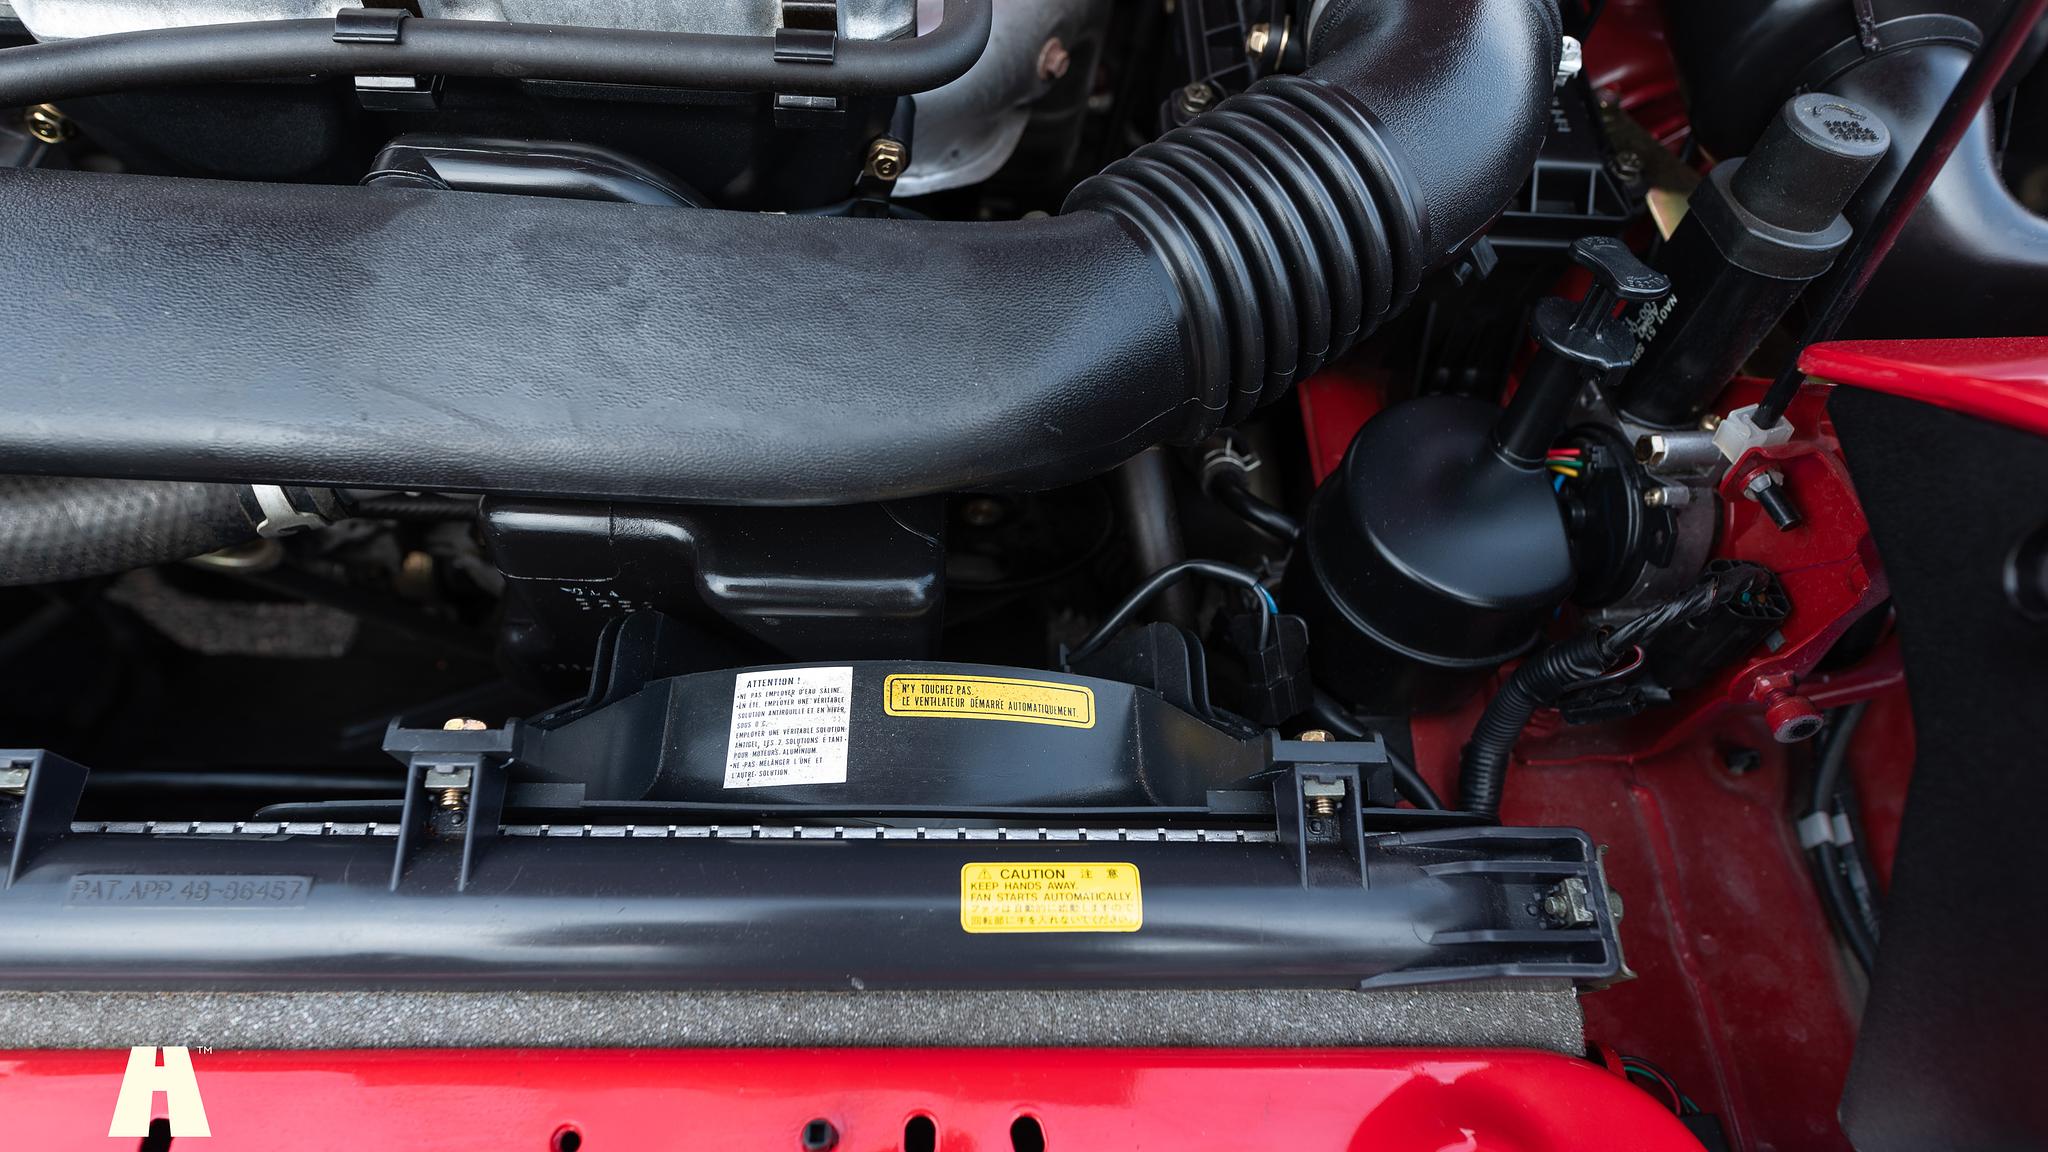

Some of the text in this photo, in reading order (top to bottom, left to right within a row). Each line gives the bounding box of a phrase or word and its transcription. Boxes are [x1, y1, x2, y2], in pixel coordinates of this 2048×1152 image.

[746, 677, 794, 688] ATTENTION
[765, 689, 795, 697] EMPLOYER
[921, 684, 954, 695] TOUCHEZ
[956, 685, 974, 696] PAS.
[764, 699, 795, 707] EMPLOYER
[797, 697, 809, 705] UNE
[902, 696, 910, 707] LE
[914, 696, 965, 708] VENTILATEUR
[738, 710, 765, 719] SOLUTION
[768, 708, 804, 716] ANTIROUILLE
[735, 730, 765, 739] EMPLOYER
[763, 739, 774, 748] LES
[785, 736, 818, 745] SOLUTIONS
[733, 751, 748, 759] POUR
[1000, 868, 1065, 880] CAUTION
[970, 882, 999, 891] KEEP
[1004, 882, 1042, 891] HANDS
[970, 893, 991, 902] FAN
[997, 893, 1038, 902] STARTS
